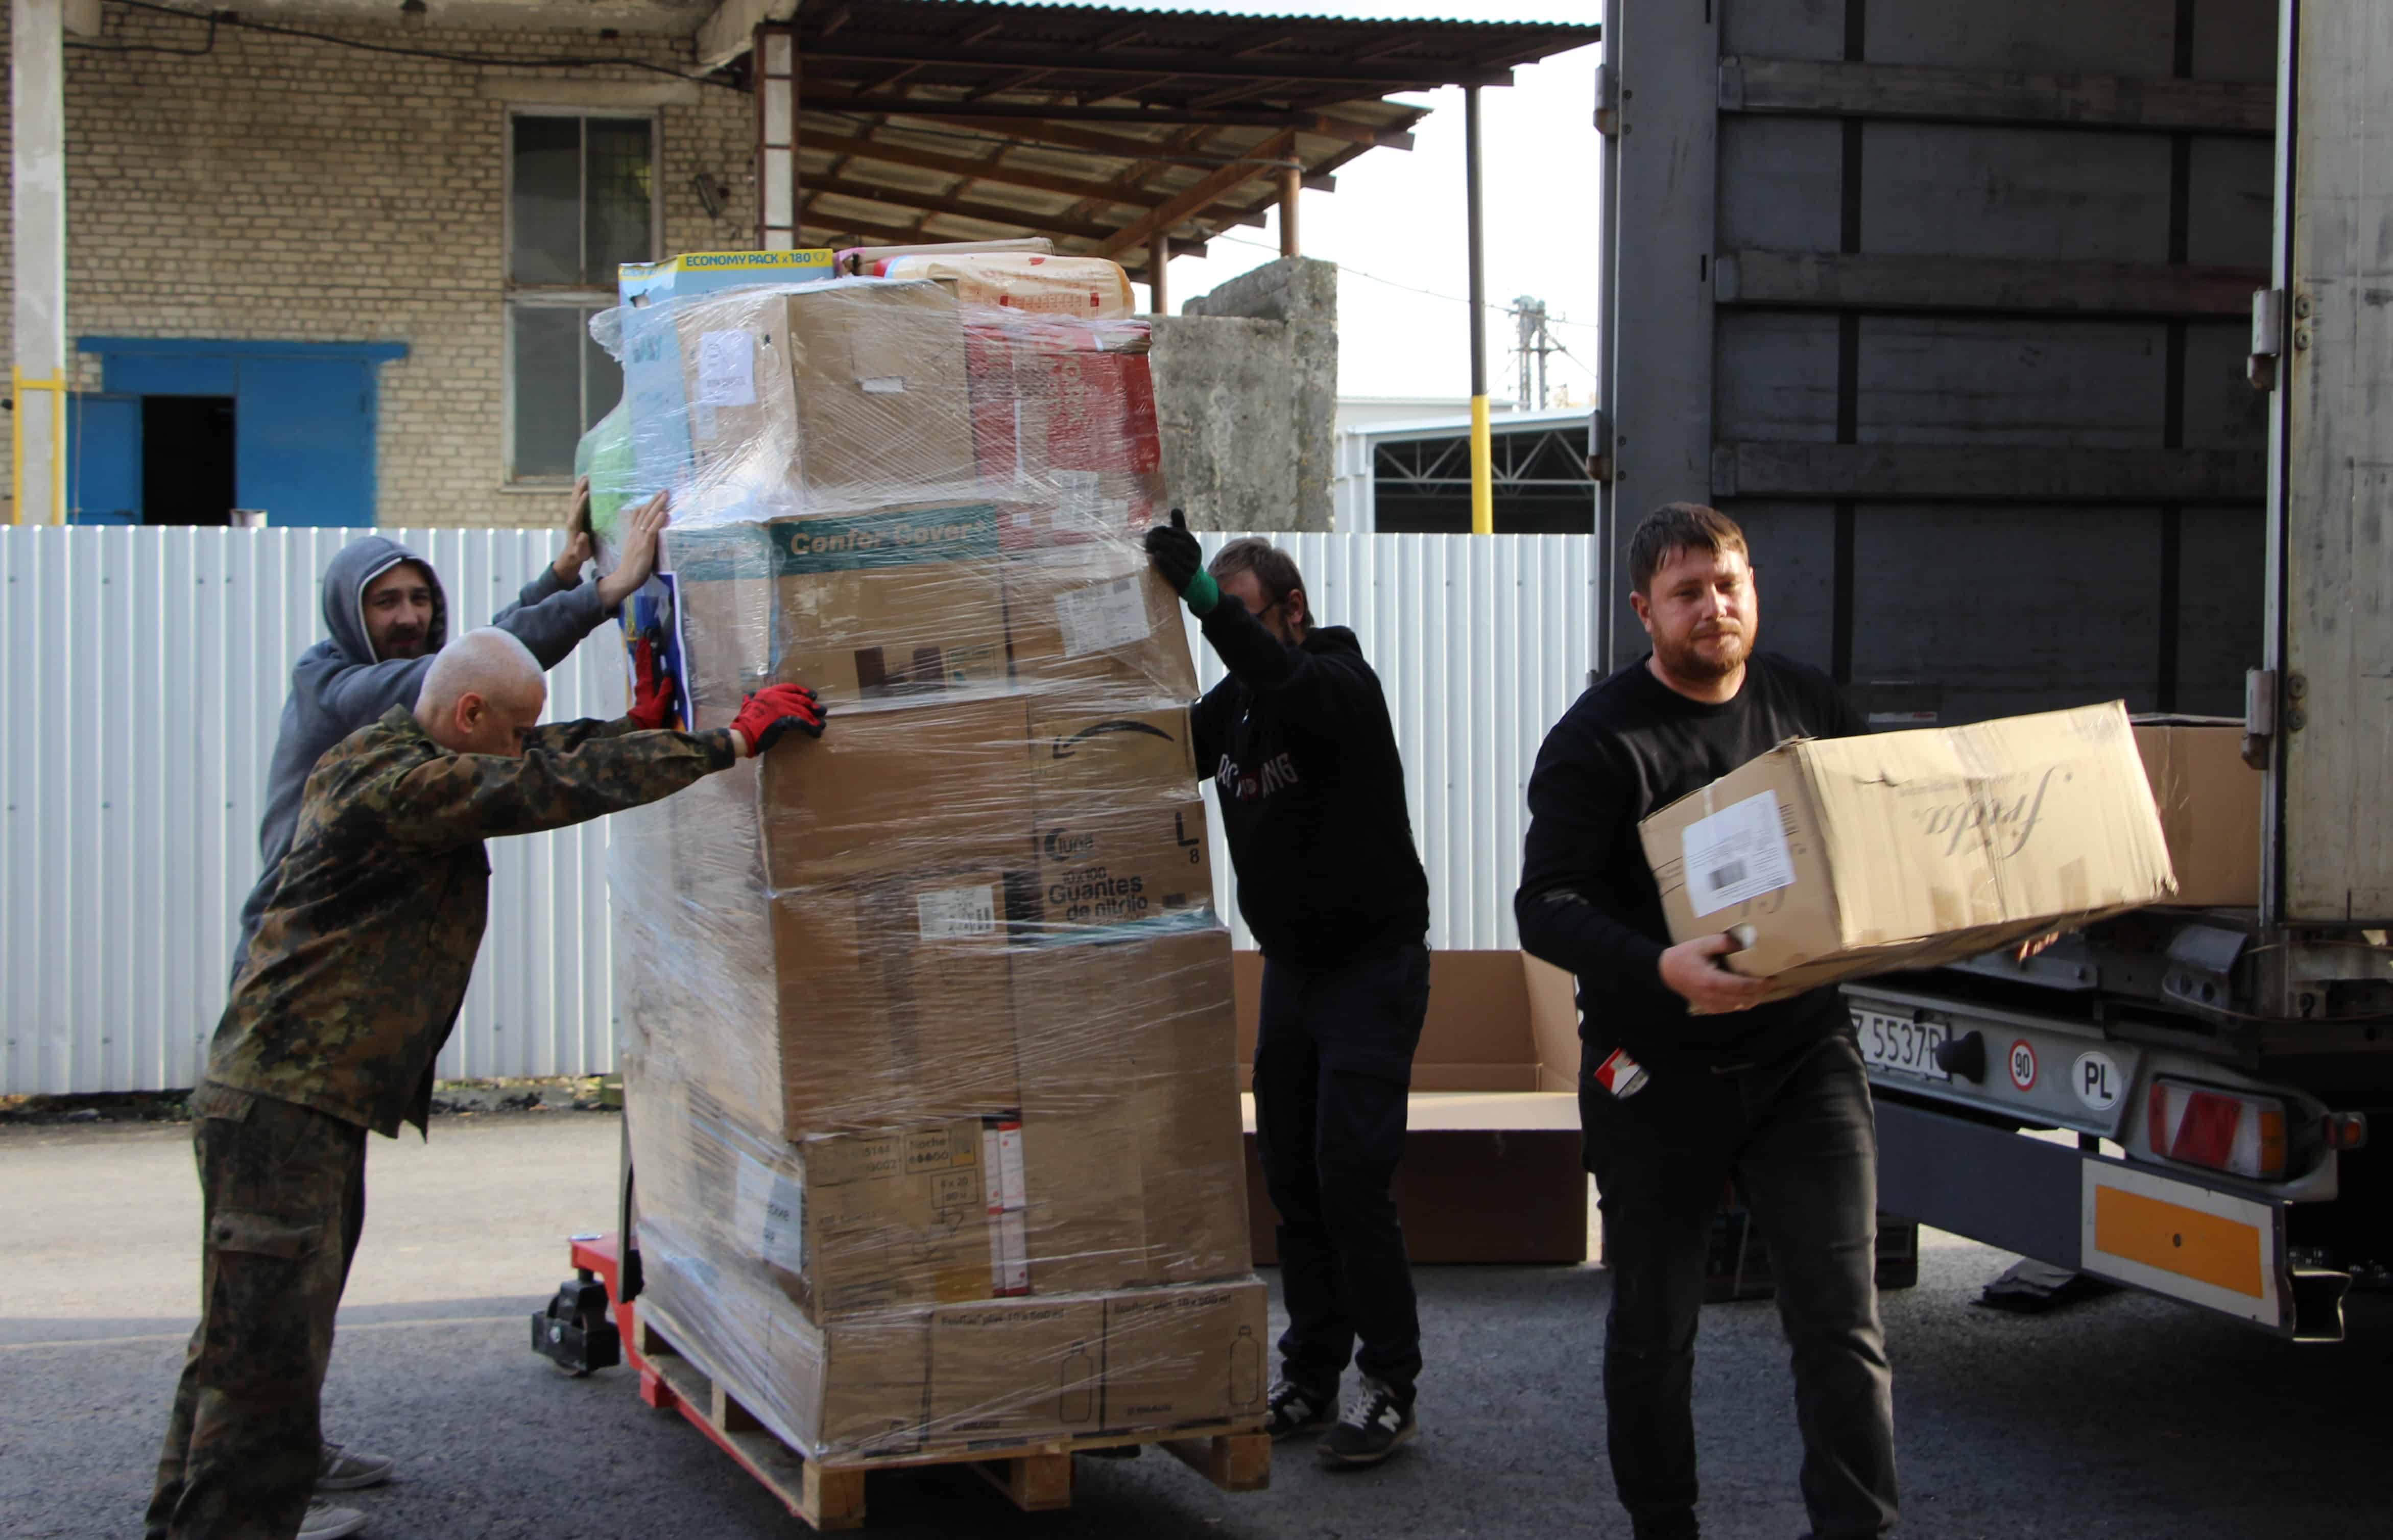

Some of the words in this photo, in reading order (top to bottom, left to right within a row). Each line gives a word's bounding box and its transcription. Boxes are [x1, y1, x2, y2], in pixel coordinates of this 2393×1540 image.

[686, 255, 745, 267] ECONOMY
[748, 253, 779, 265] PACK
[789, 252, 811, 263] 180
[1176, 812, 1199, 847] L
[1189, 848, 1200, 864] 8
[1048, 876, 1143, 904] Guantes
[1066, 904, 1090, 921] de
[2015, 1052, 2030, 1079] 90
[2084, 1061, 2113, 1100] PL
